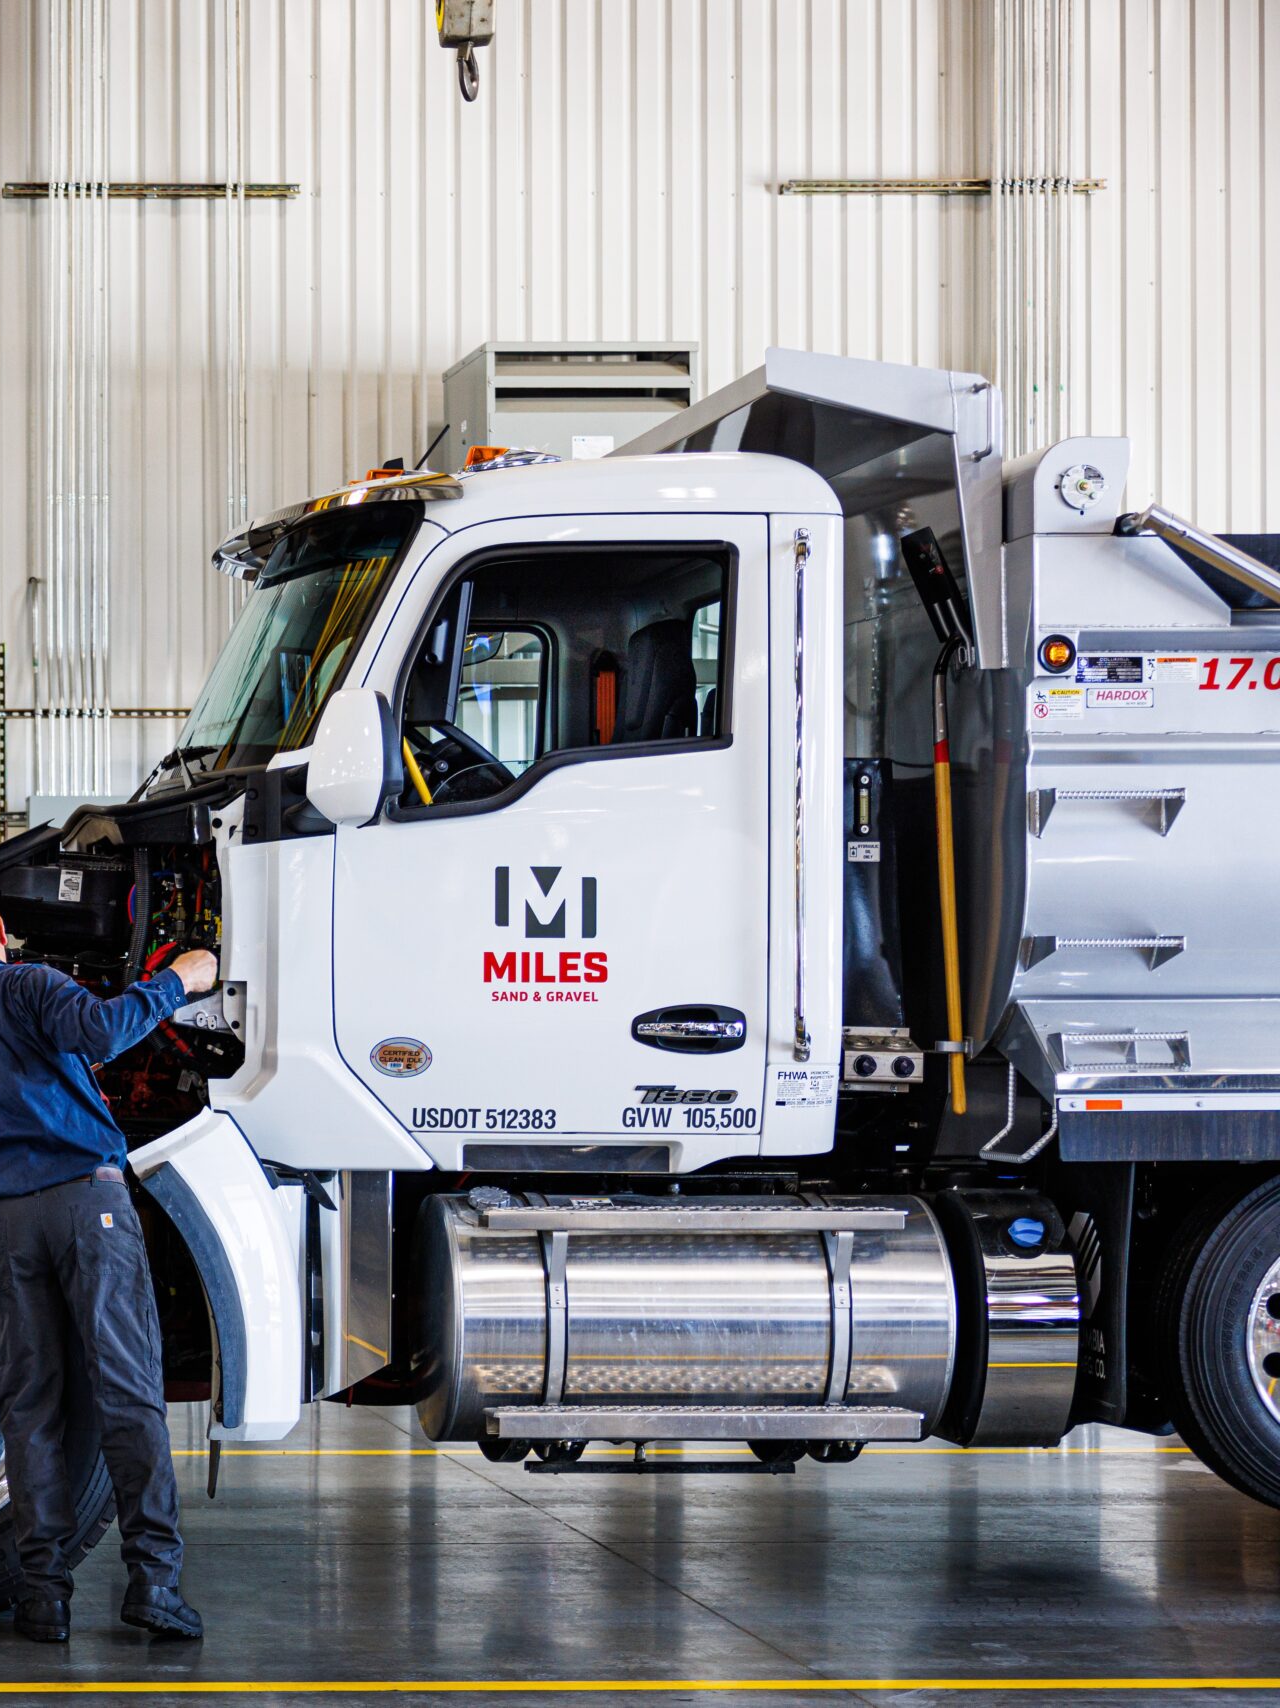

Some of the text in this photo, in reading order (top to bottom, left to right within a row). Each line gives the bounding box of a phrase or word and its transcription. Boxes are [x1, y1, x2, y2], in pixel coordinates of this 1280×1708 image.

[1096, 689, 1149, 701] HARDOX
[483, 951, 608, 983] MILES
[491, 991, 599, 1002] SAND & GRAVEL
[777, 1071, 808, 1080] FHWA
[634, 1085, 739, 1105] T880
[412, 1107, 557, 1130] USDOT 512383
[622, 1107, 757, 1132] GVW 105,500
